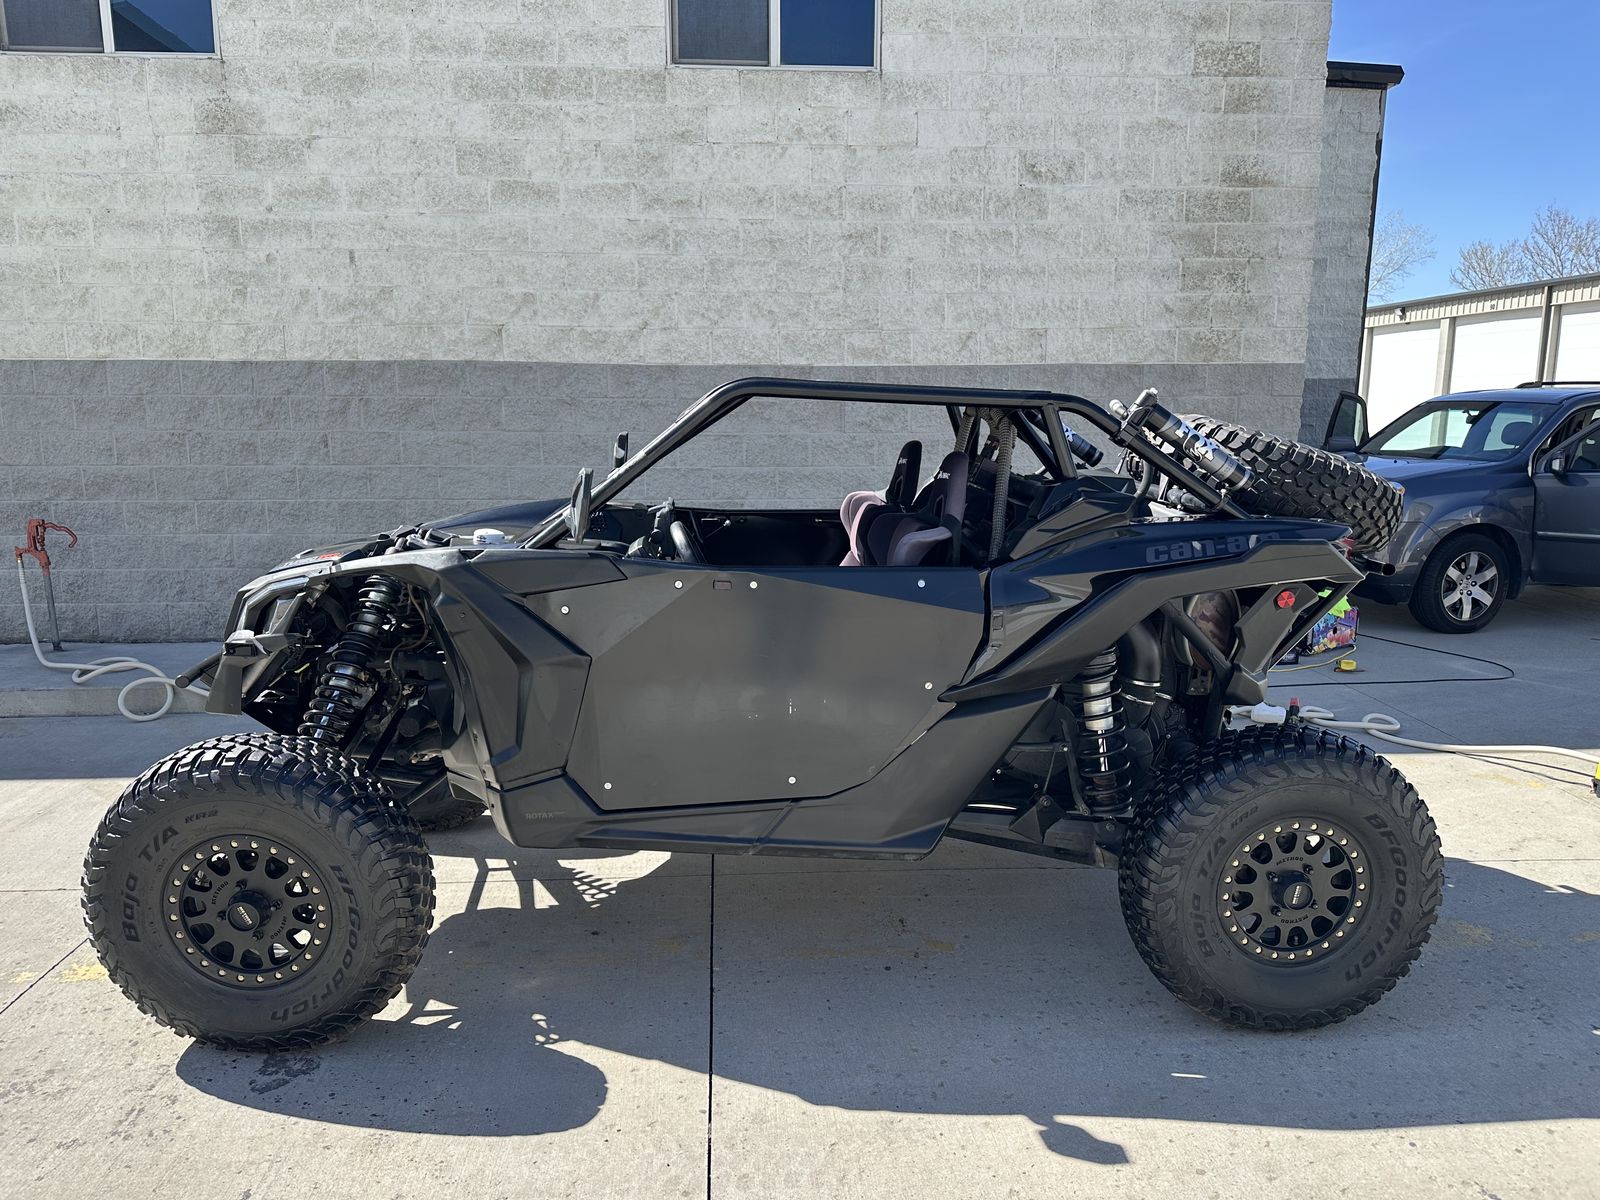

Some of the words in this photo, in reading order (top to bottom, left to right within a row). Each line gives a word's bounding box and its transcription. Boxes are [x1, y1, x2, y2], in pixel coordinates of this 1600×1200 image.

[1174, 420, 1223, 462] FOX
[525, 812, 554, 820] ROTAX
[1197, 835, 1227, 878] T/A
[1276, 856, 1304, 866] METHOD
[122, 871, 141, 942] Baja
[138, 825, 179, 862] T/A
[211, 880, 229, 905] METHOD
[1345, 813, 1407, 982] BFGoodrich
[270, 915, 287, 940] METHOD
[1190, 893, 1216, 957] Baja
[1280, 913, 1309, 924] METHOD
[271, 864, 361, 1022] BFGoodrich
